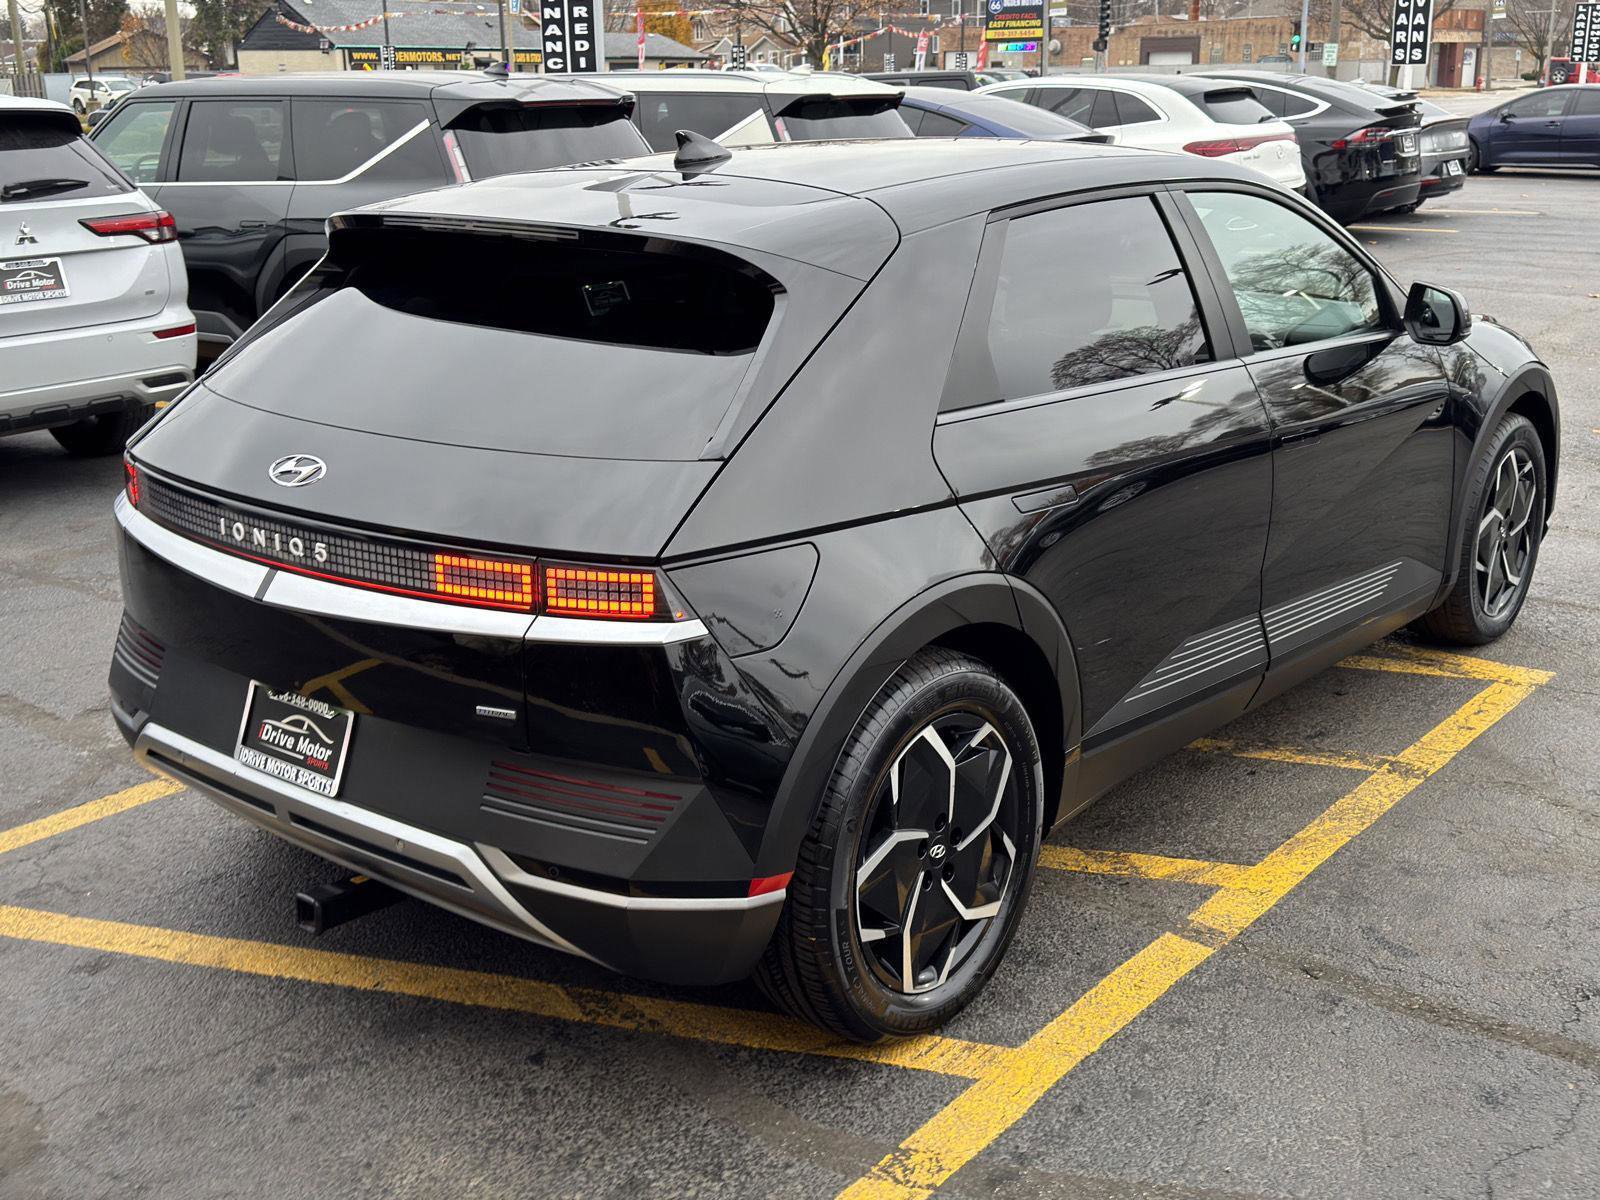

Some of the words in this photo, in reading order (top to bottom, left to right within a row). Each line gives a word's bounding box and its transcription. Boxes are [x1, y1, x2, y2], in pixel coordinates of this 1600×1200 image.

[989, 20, 1006, 28] EASY
[1005, 19, 1041, 28] FINANCING
[990, 1, 1001, 10] 66
[1394, 0, 1410, 61] CARS
[1411, 0, 1426, 61] VANS
[543, 0, 564, 69] NANC
[1572, 5, 1587, 62] LARGEST
[1587, 5, 1600, 62] INVENTORY
[220, 517, 304, 557] IONIQ
[314, 542, 327, 562] 5
[258, 722, 295, 750] iDrive
[296, 735, 332, 761] Motor
[266, 758, 297, 781] MOTOR
[298, 770, 332, 794] SPORTS
